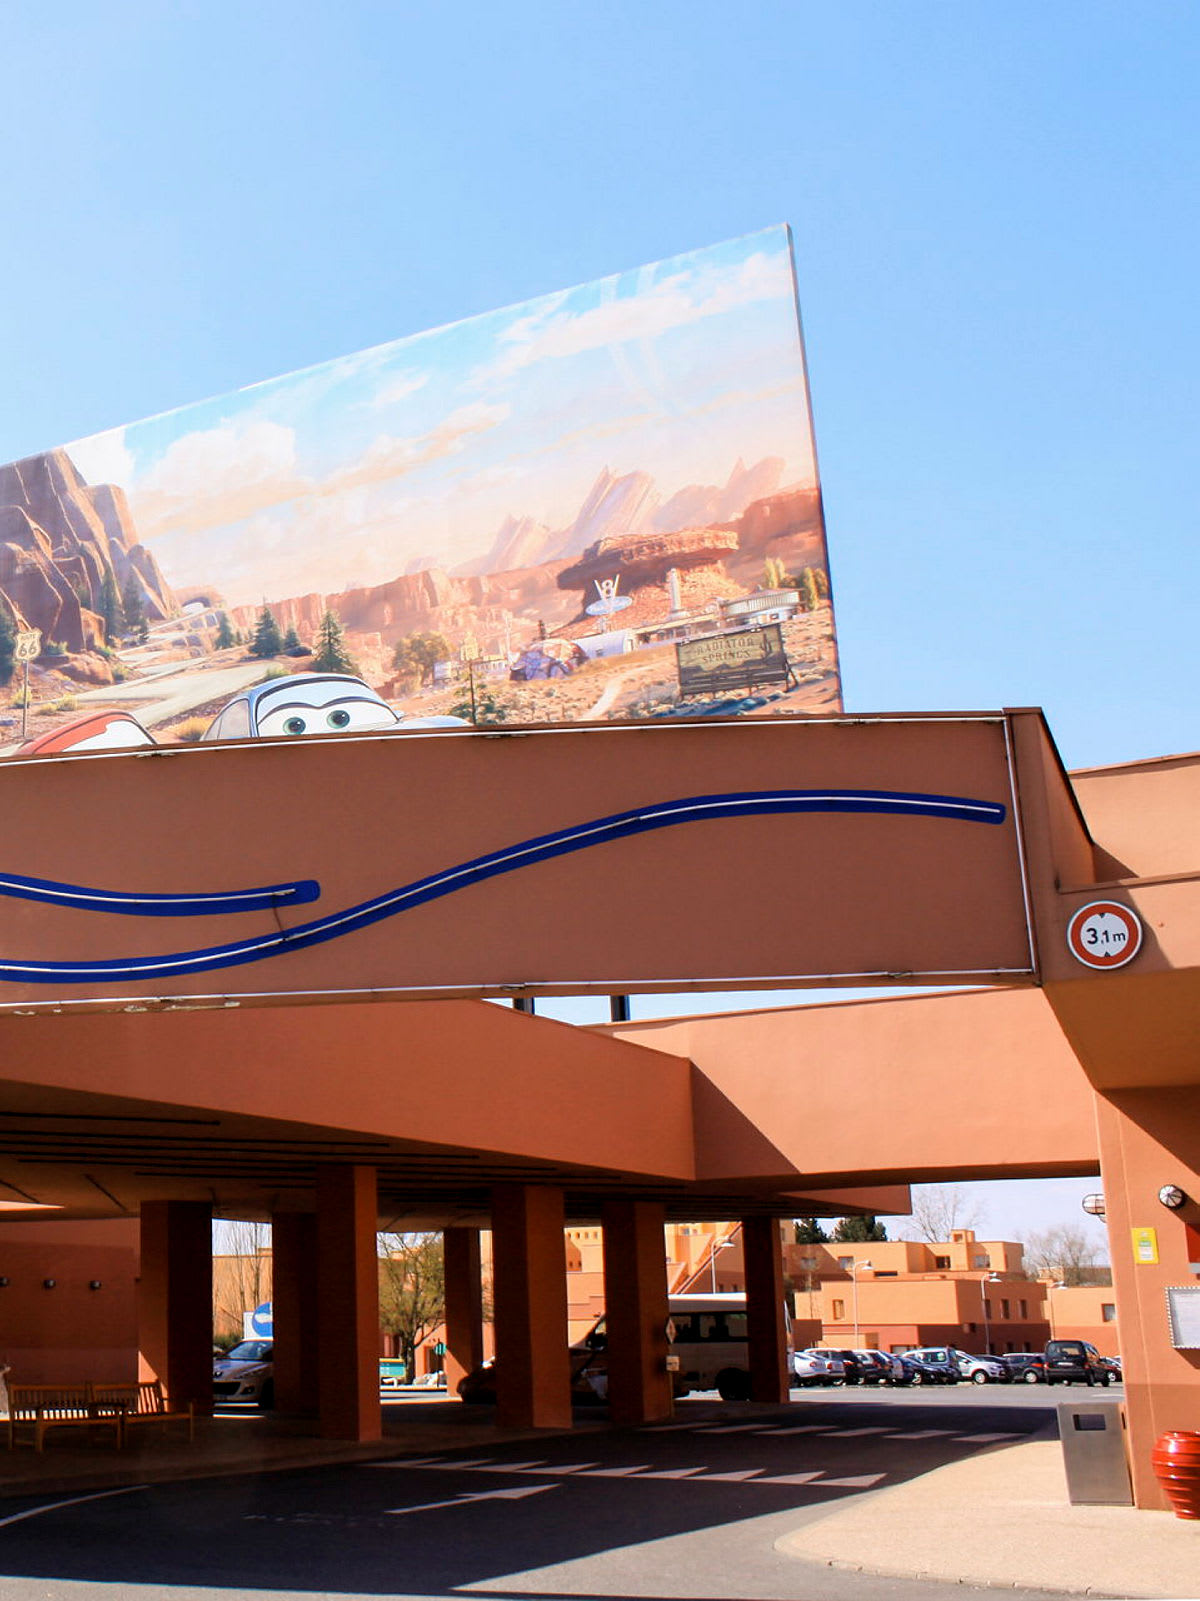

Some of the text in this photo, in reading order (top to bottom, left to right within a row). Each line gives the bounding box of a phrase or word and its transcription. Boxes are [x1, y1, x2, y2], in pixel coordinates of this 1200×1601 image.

[18, 640, 38, 657] 66
[696, 637, 755, 656] RADIATOR
[702, 649, 752, 664] SPRINGS
